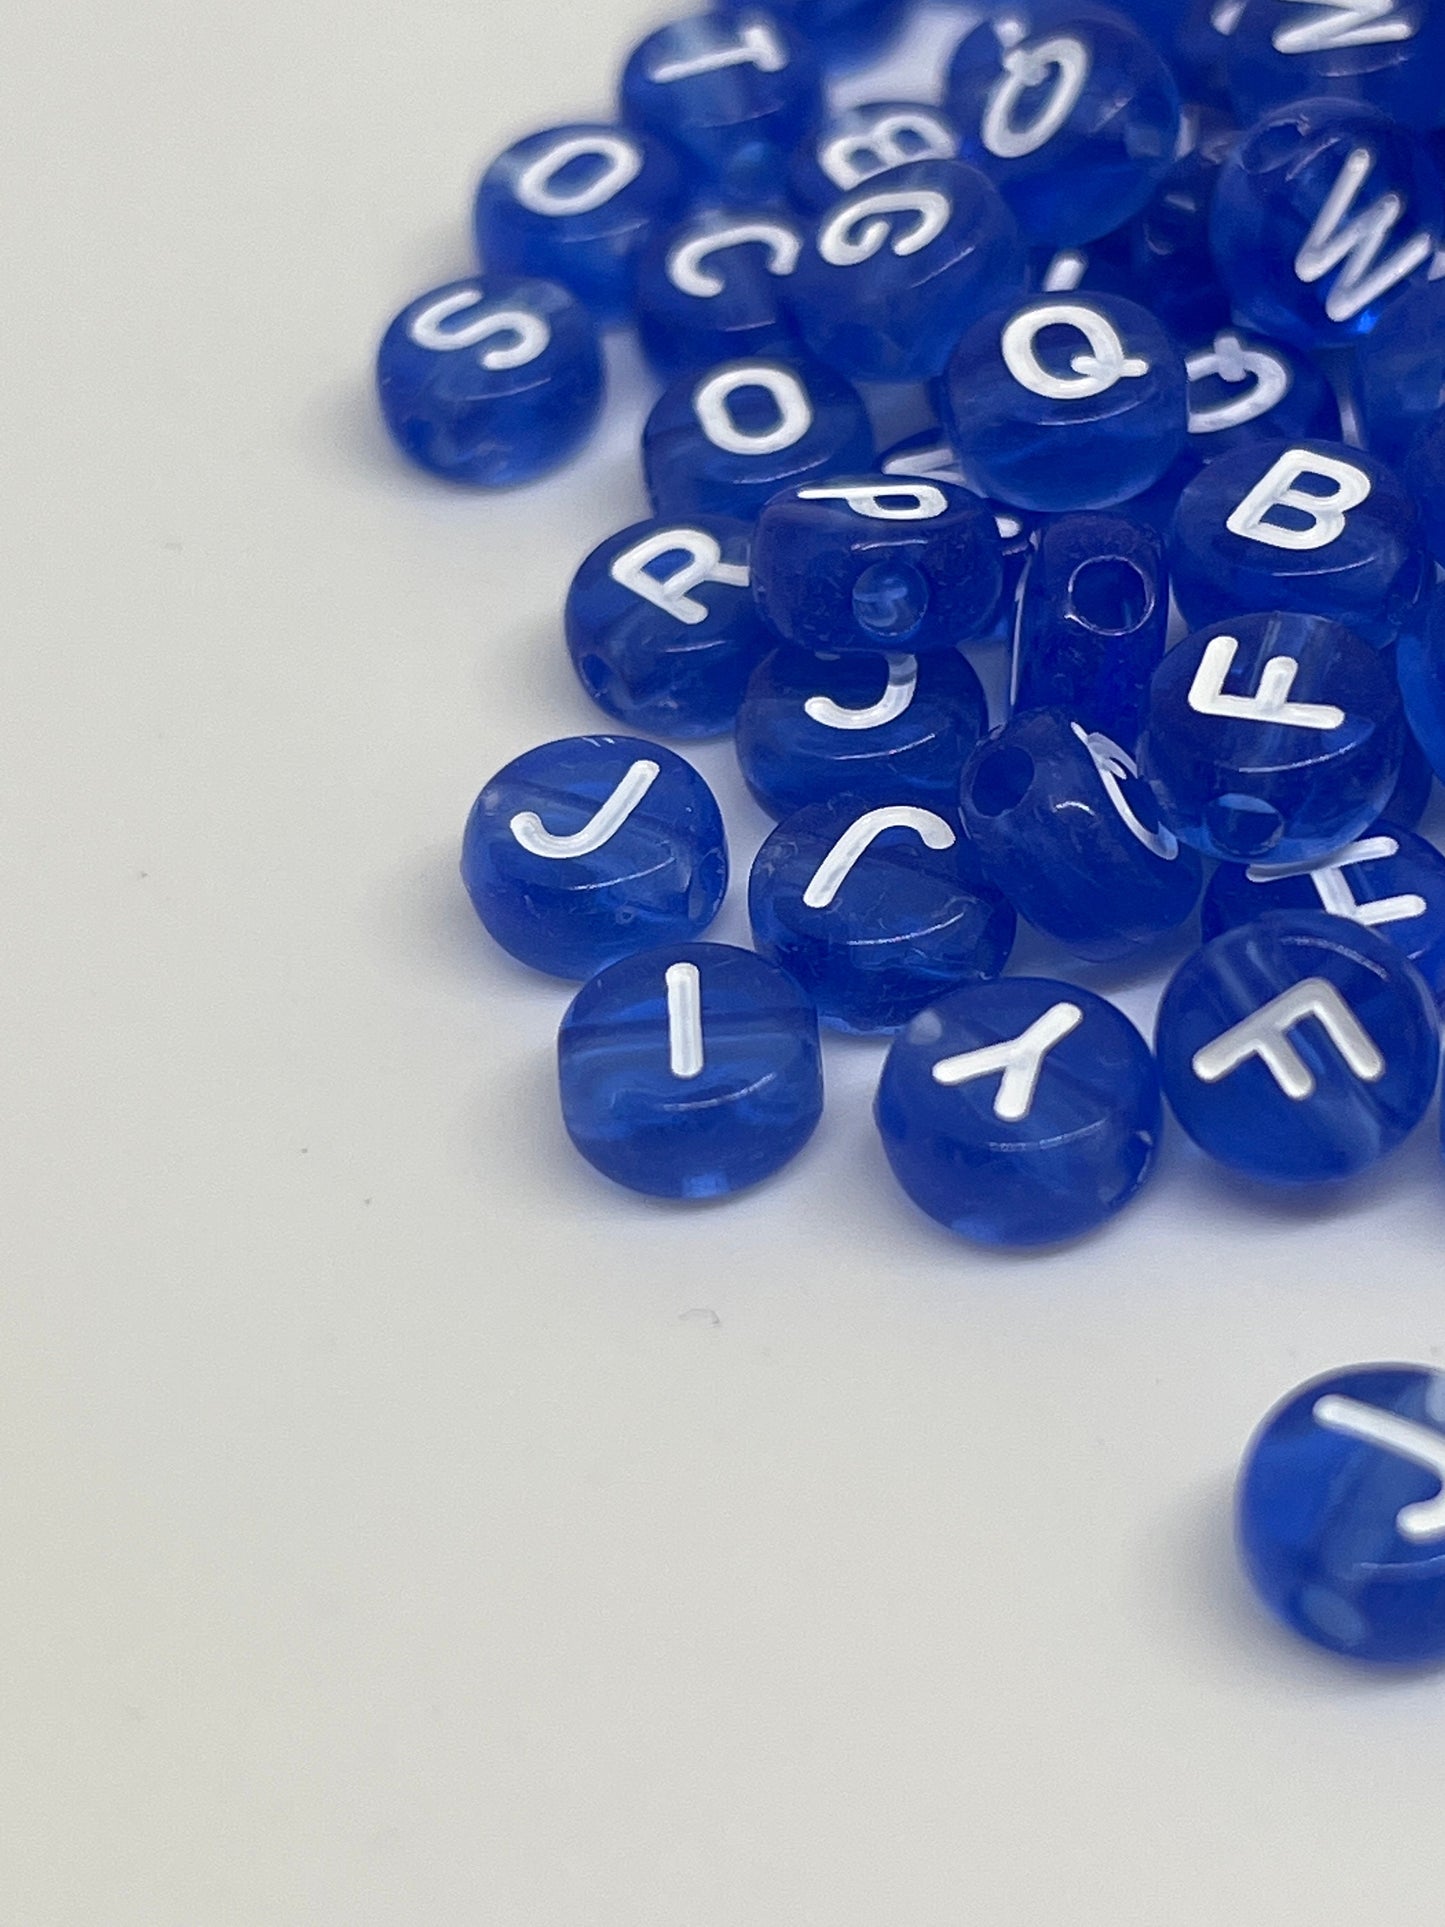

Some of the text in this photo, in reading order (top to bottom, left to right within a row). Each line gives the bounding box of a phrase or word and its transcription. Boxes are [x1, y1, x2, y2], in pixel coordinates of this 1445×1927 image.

[651, 25, 785, 83] T
[985, 17, 1088, 158] Q
[516, 135, 642, 216] O
[819, 112, 957, 191] B
[668, 224, 800, 297] C
[818, 190, 951, 266] G
[1294, 147, 1431, 322] W
[408, 289, 551, 370] S
[1001, 304, 1150, 400] Q
[694, 366, 812, 456] O
[797, 484, 949, 520] P
[1226, 448, 1372, 550] B
[612, 529, 750, 625] R
[1188, 635, 1346, 730] F
[509, 759, 661, 859] J
[802, 805, 956, 909] J
[1245, 835, 1427, 926] H
[932, 1002, 1084, 1120] Y
[1192, 978, 1384, 1100] F
